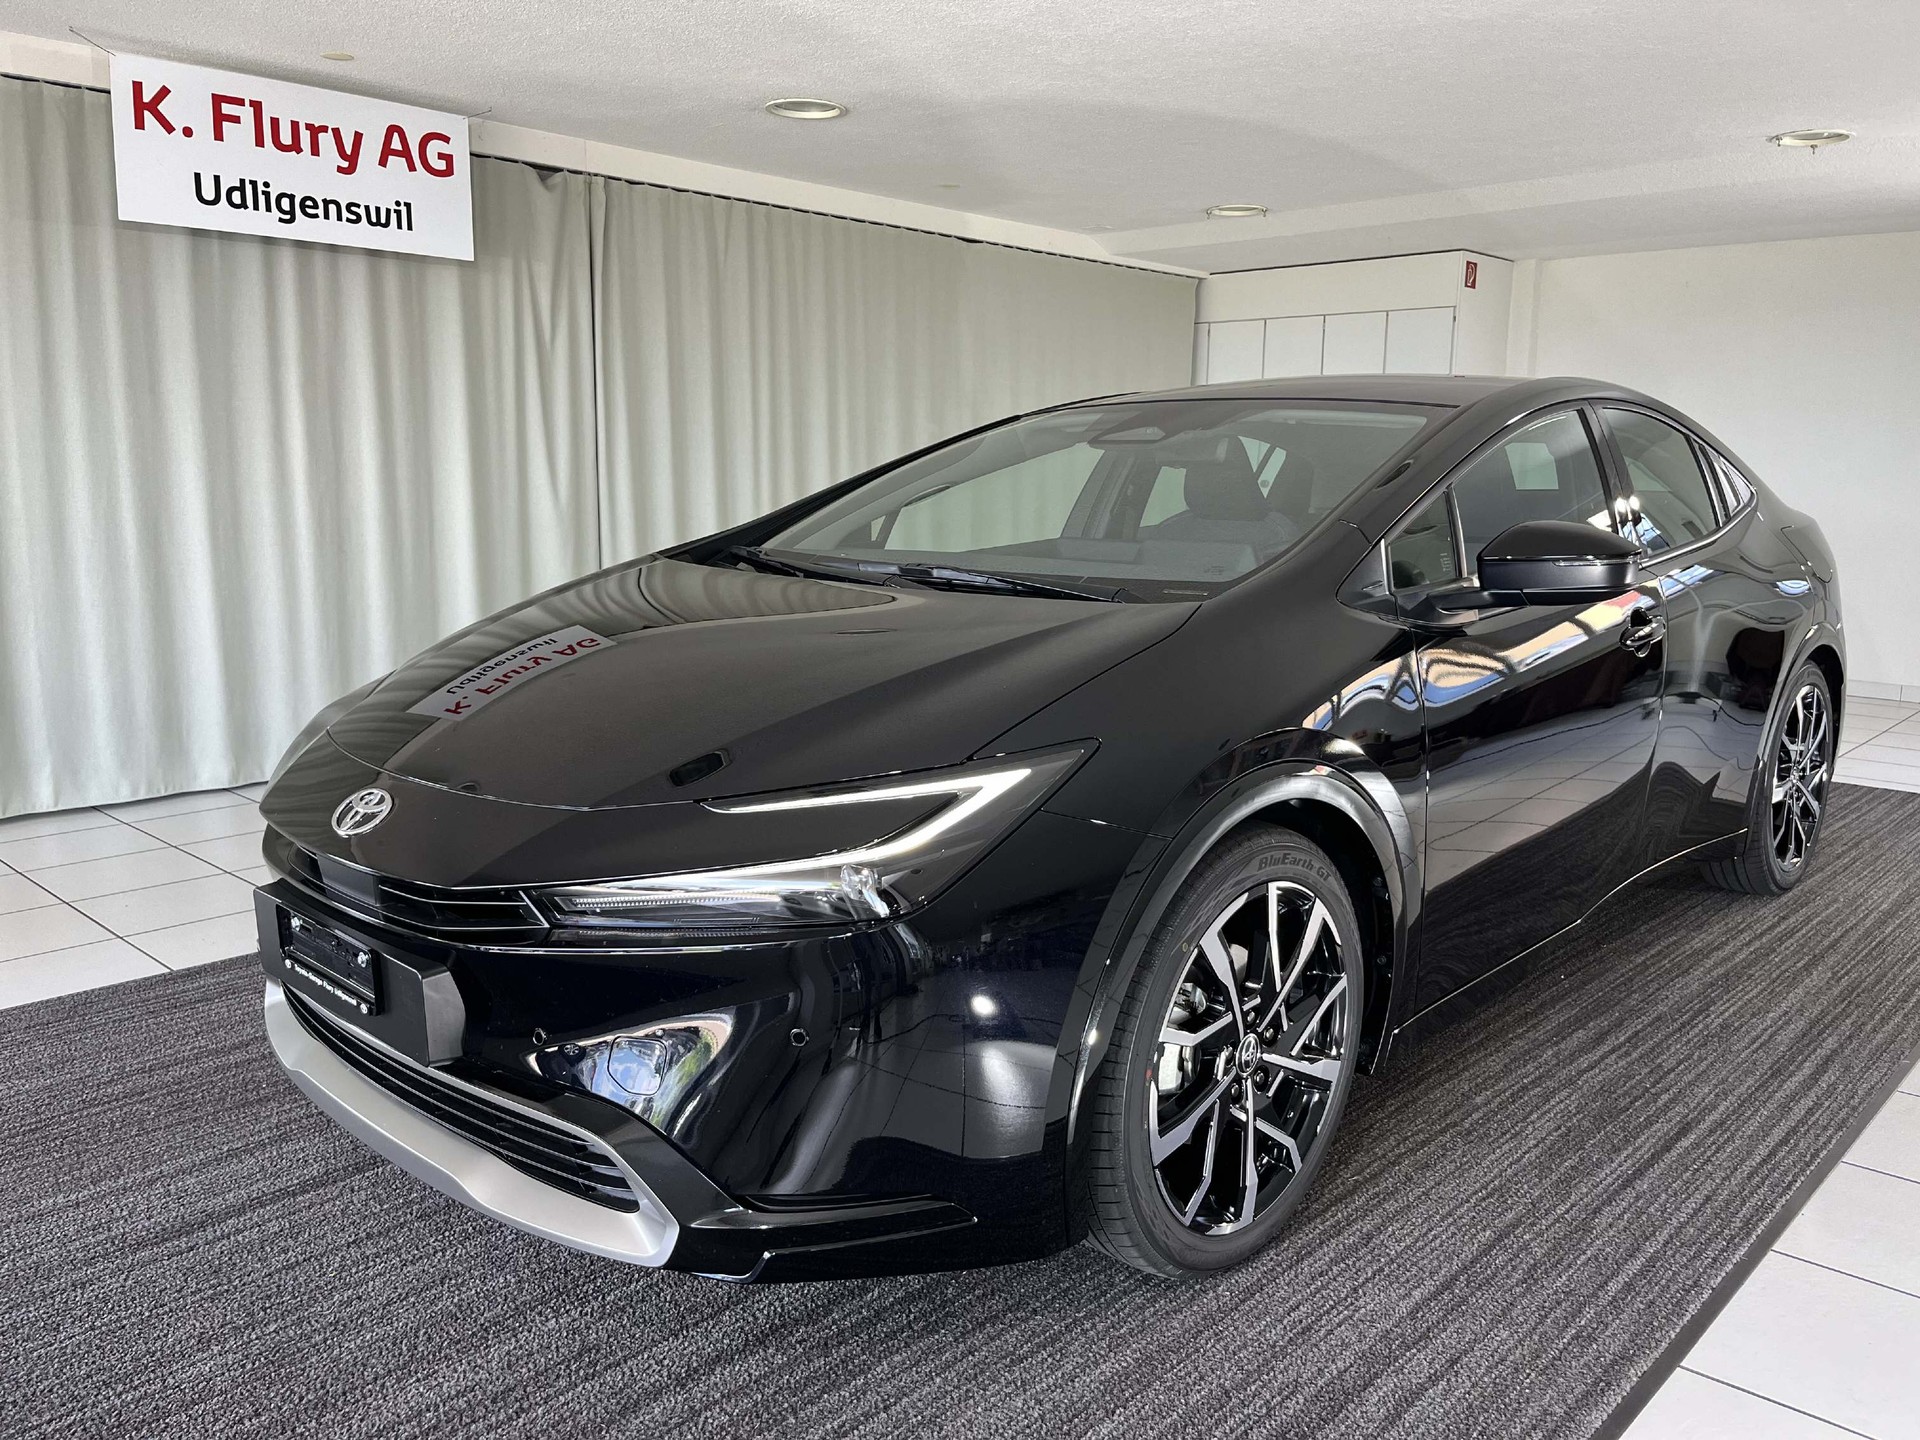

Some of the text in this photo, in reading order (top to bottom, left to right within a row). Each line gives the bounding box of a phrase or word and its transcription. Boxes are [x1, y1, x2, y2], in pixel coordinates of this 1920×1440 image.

[132, 80, 455, 177] K. Flury AG
[193, 172, 414, 231] Udligenswil
